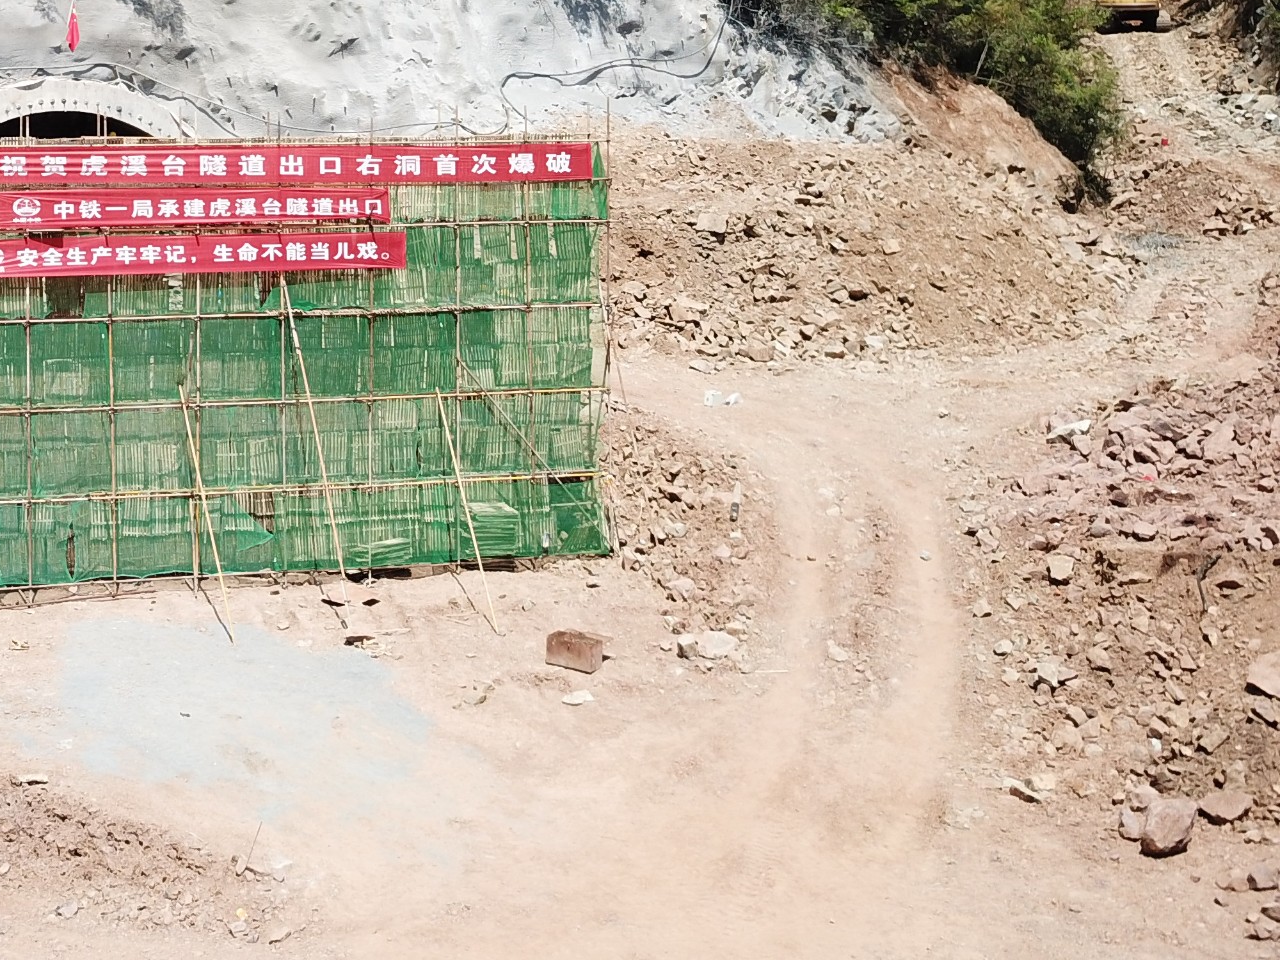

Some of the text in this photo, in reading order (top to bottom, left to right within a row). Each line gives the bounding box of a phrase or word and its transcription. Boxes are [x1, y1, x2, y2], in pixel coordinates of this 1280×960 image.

[53, 197, 383, 220] 中铁一局承建虎溪台隧道出口
